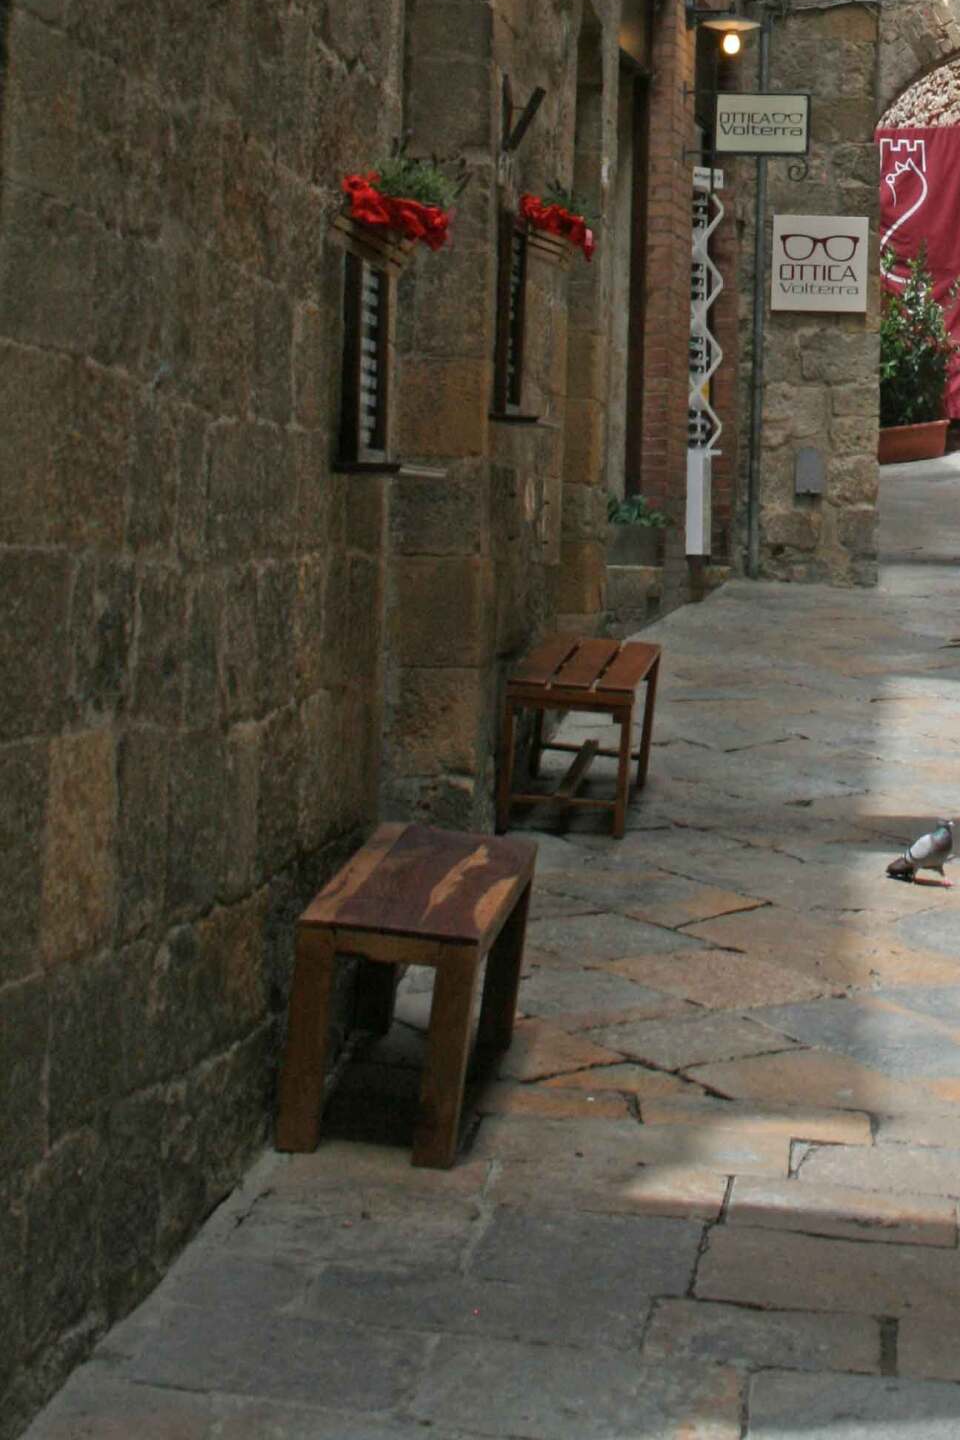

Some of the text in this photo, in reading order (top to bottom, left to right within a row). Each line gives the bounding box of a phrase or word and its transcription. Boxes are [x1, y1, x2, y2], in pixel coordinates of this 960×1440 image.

[719, 112, 772, 124] OTTICA
[719, 124, 803, 137] Volterra
[779, 264, 857, 282] OTTICA
[779, 282, 859, 296] Volterra
